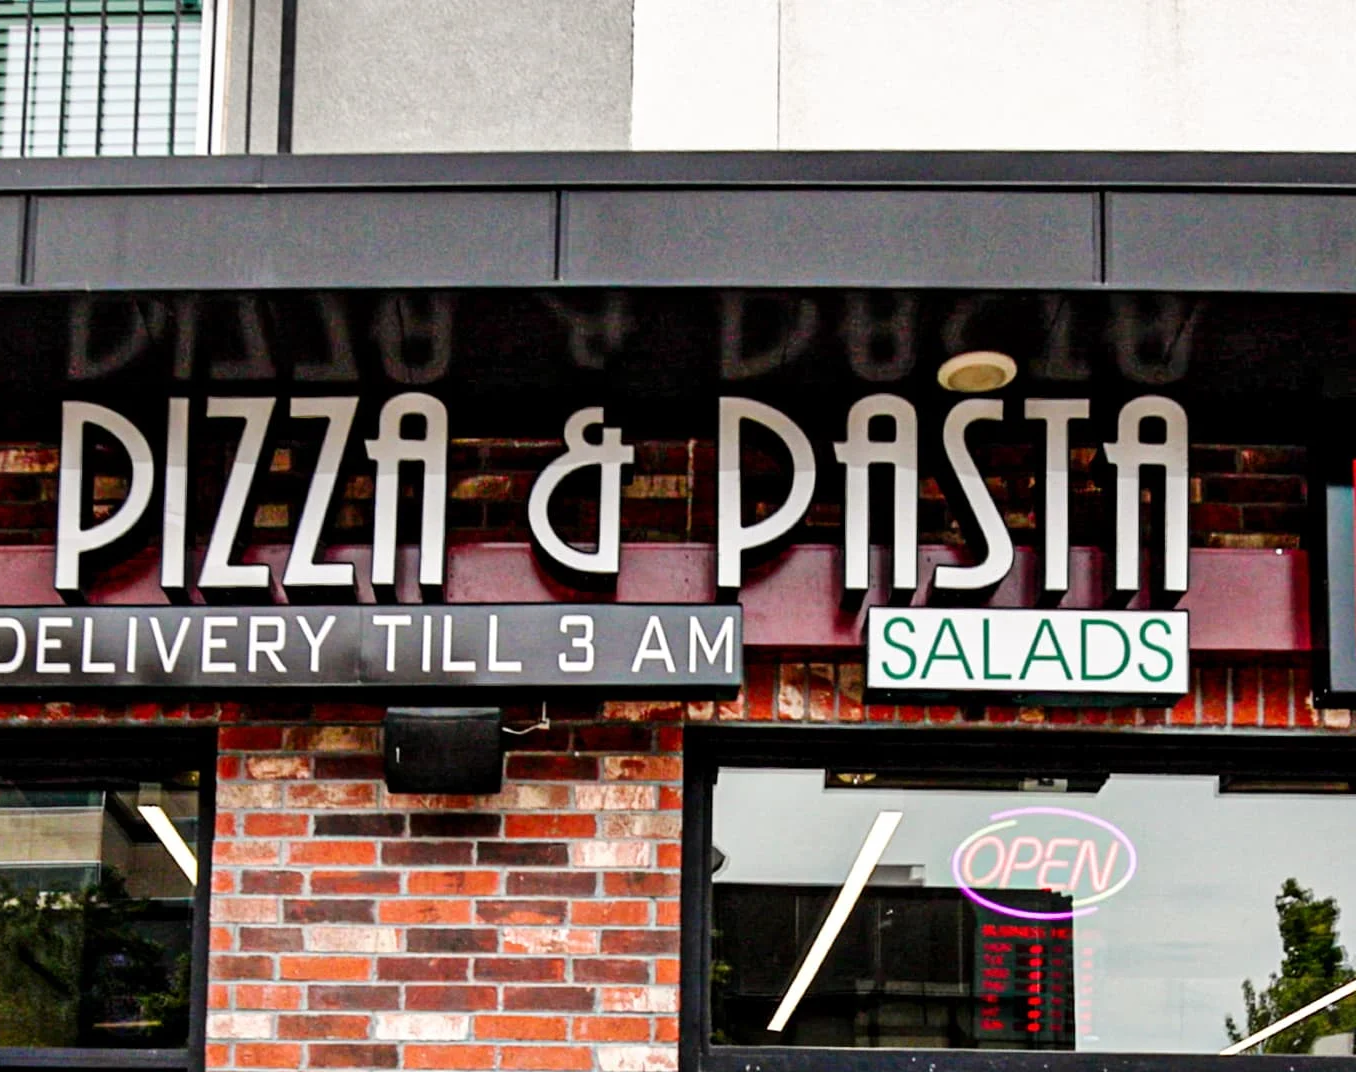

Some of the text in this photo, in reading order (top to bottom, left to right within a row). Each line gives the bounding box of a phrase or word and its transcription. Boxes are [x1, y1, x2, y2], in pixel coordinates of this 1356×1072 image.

[53, 392, 449, 592] PIZZA
[528, 406, 636, 575] &
[716, 393, 1190, 593] PASTA
[373, 613, 522, 674] TILL
[558, 615, 595, 674] 3
[631, 614, 735, 674] AM
[879, 616, 1175, 682] SALADS
[961, 835, 1119, 892] OPEN
